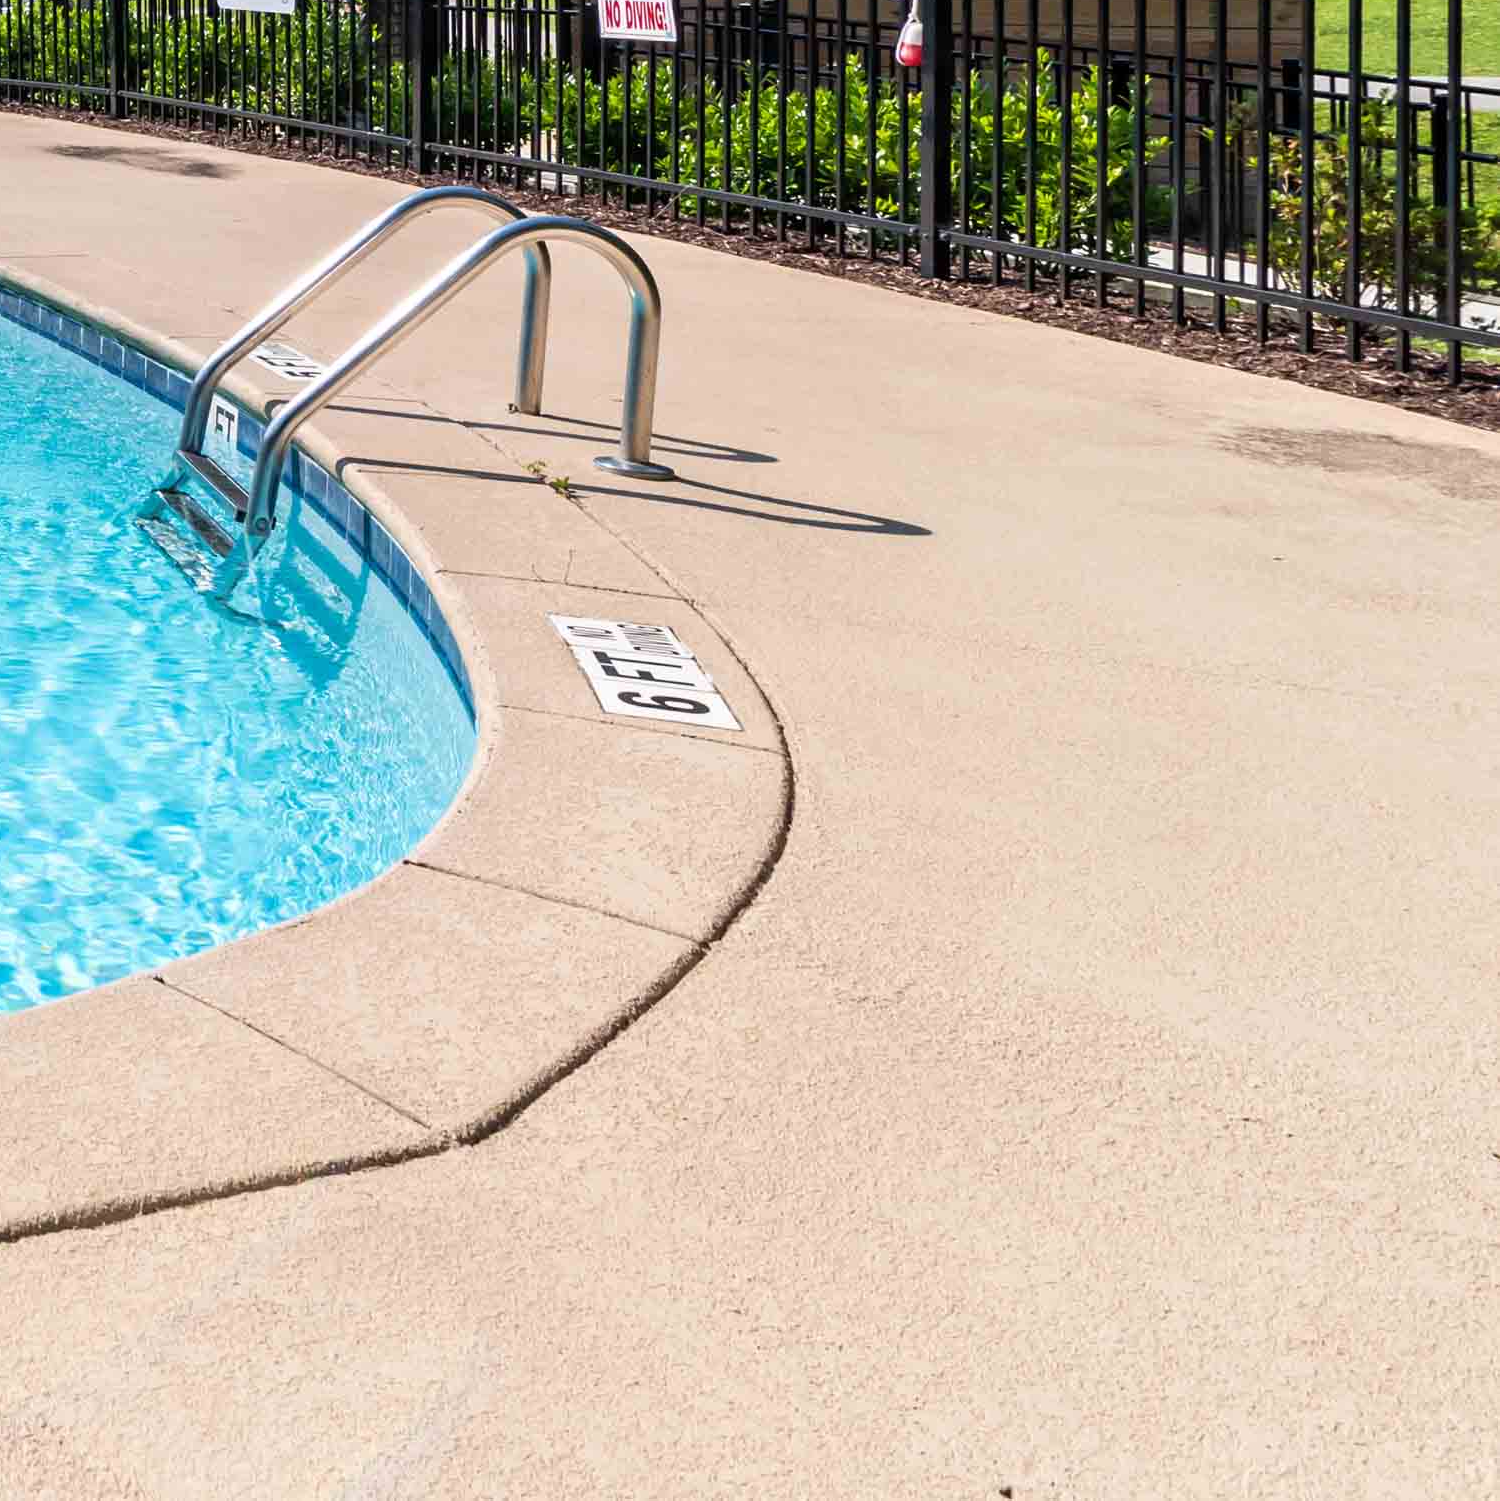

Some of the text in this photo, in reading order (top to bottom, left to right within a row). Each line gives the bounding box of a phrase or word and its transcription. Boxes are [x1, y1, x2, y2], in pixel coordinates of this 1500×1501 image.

[605, 0, 668, 31] NO DIVING!
[257, 355, 318, 369] FT
[215, 405, 235, 442] FT
[593, 650, 711, 714] 6 FT
